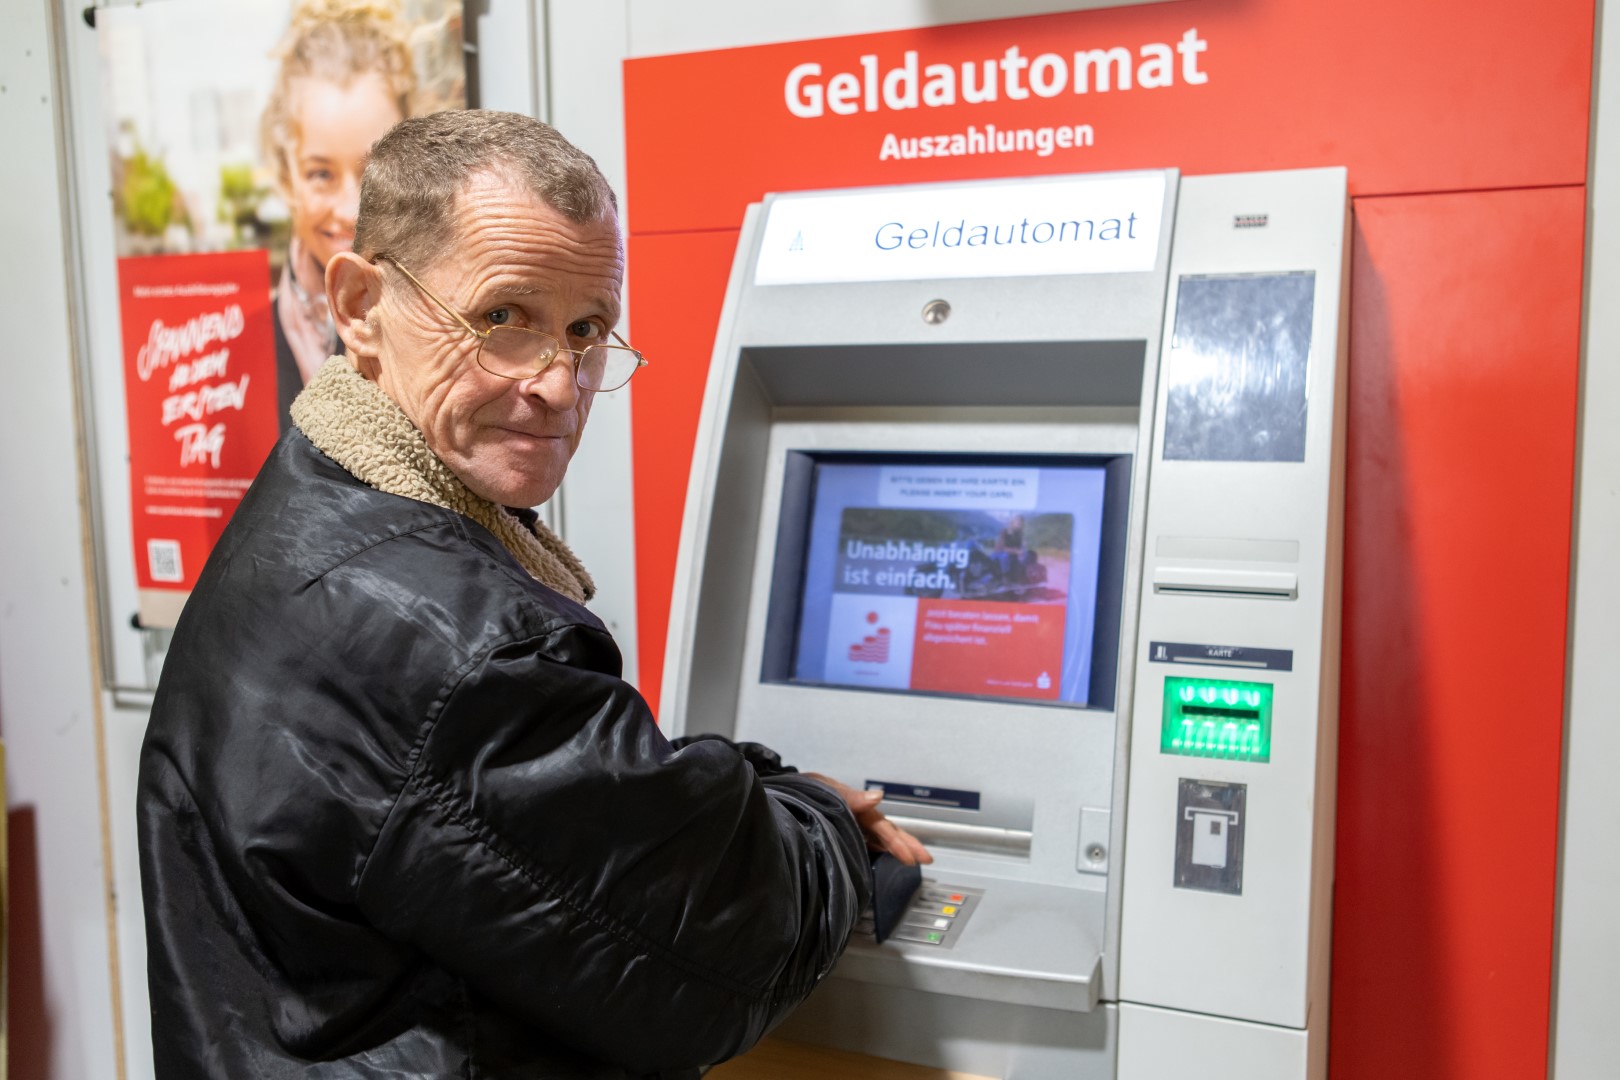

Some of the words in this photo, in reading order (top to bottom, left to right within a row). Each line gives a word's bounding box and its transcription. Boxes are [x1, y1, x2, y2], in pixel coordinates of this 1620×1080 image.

[784, 28, 1208, 118] Geldautomat
[879, 124, 1094, 161] Auszahlungen
[875, 212, 1138, 250] Geldautomat
[137, 303, 245, 381] SPANNEND
[161, 374, 251, 426] ERSTEN
[174, 422, 226, 469] TAG
[847, 540, 970, 568] Unabhängig
[844, 566, 871, 585] ist
[875, 569, 956, 589] einfach.
[1208, 648, 1233, 658] KARTE
